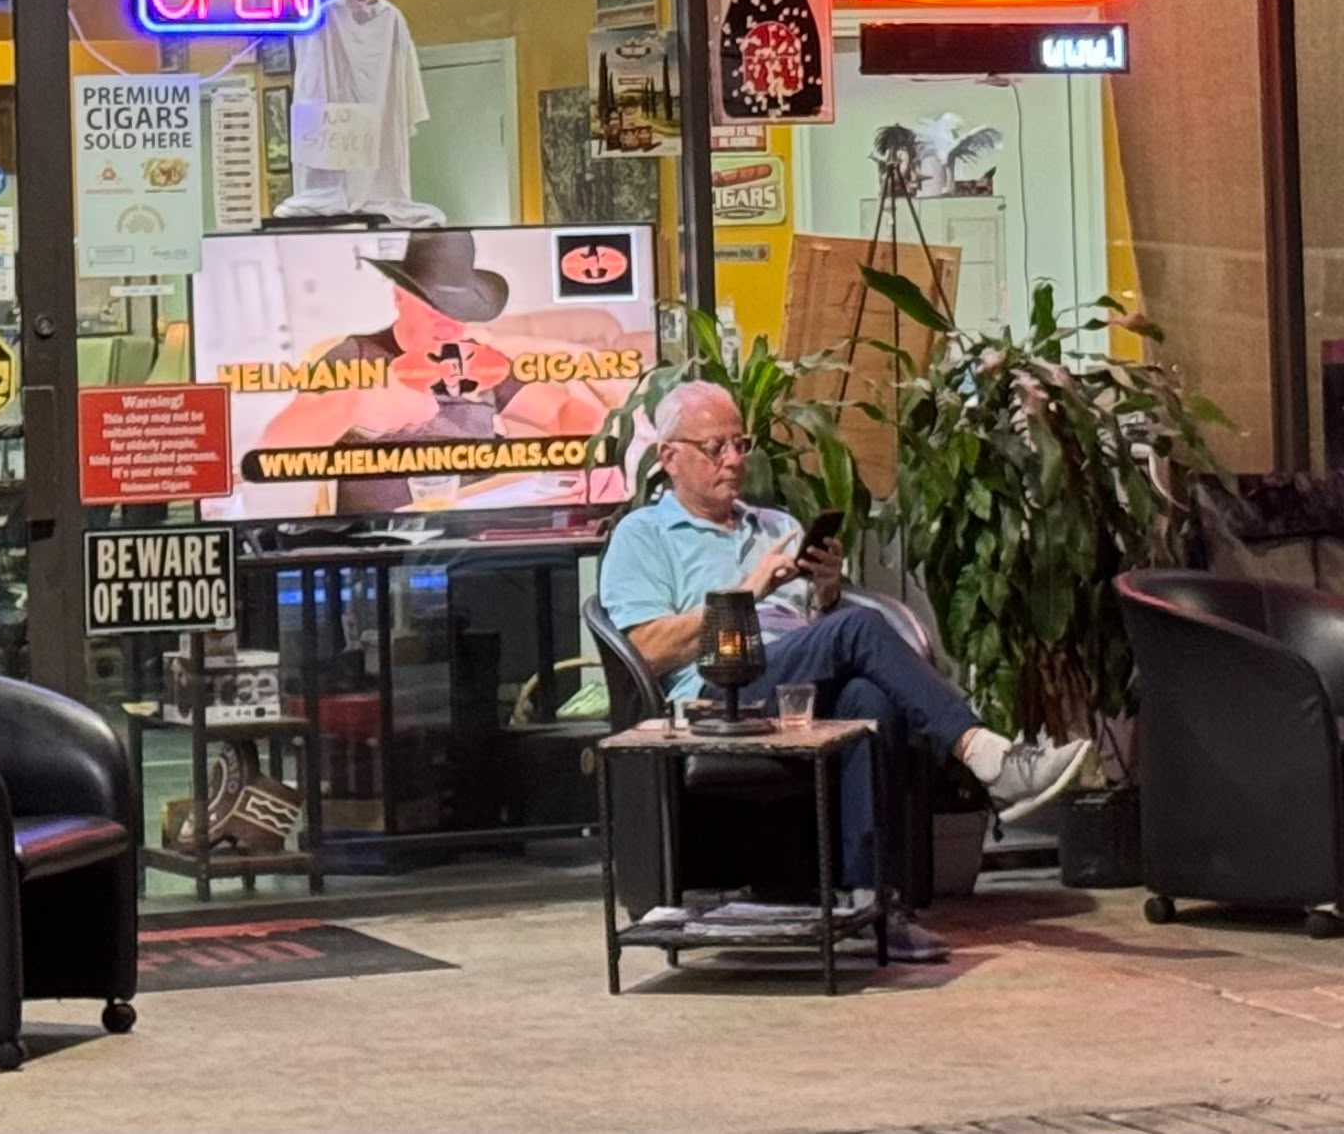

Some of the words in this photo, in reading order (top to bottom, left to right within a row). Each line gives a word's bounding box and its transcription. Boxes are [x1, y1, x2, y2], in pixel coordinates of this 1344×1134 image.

[83, 85, 191, 106] PREMIUM
[86, 106, 189, 131] CIGARS
[83, 133, 137, 151] SOLD
[141, 131, 193, 149] HERE
[712, 185, 777, 209] IGARS
[218, 357, 386, 392] HELMANN
[513, 348, 643, 384] CIGARS
[121, 393, 185, 410] Warning!
[96, 534, 222, 580] BEWARE
[93, 582, 124, 624] OF
[127, 580, 174, 622] THE
[177, 578, 227, 620] DOG
